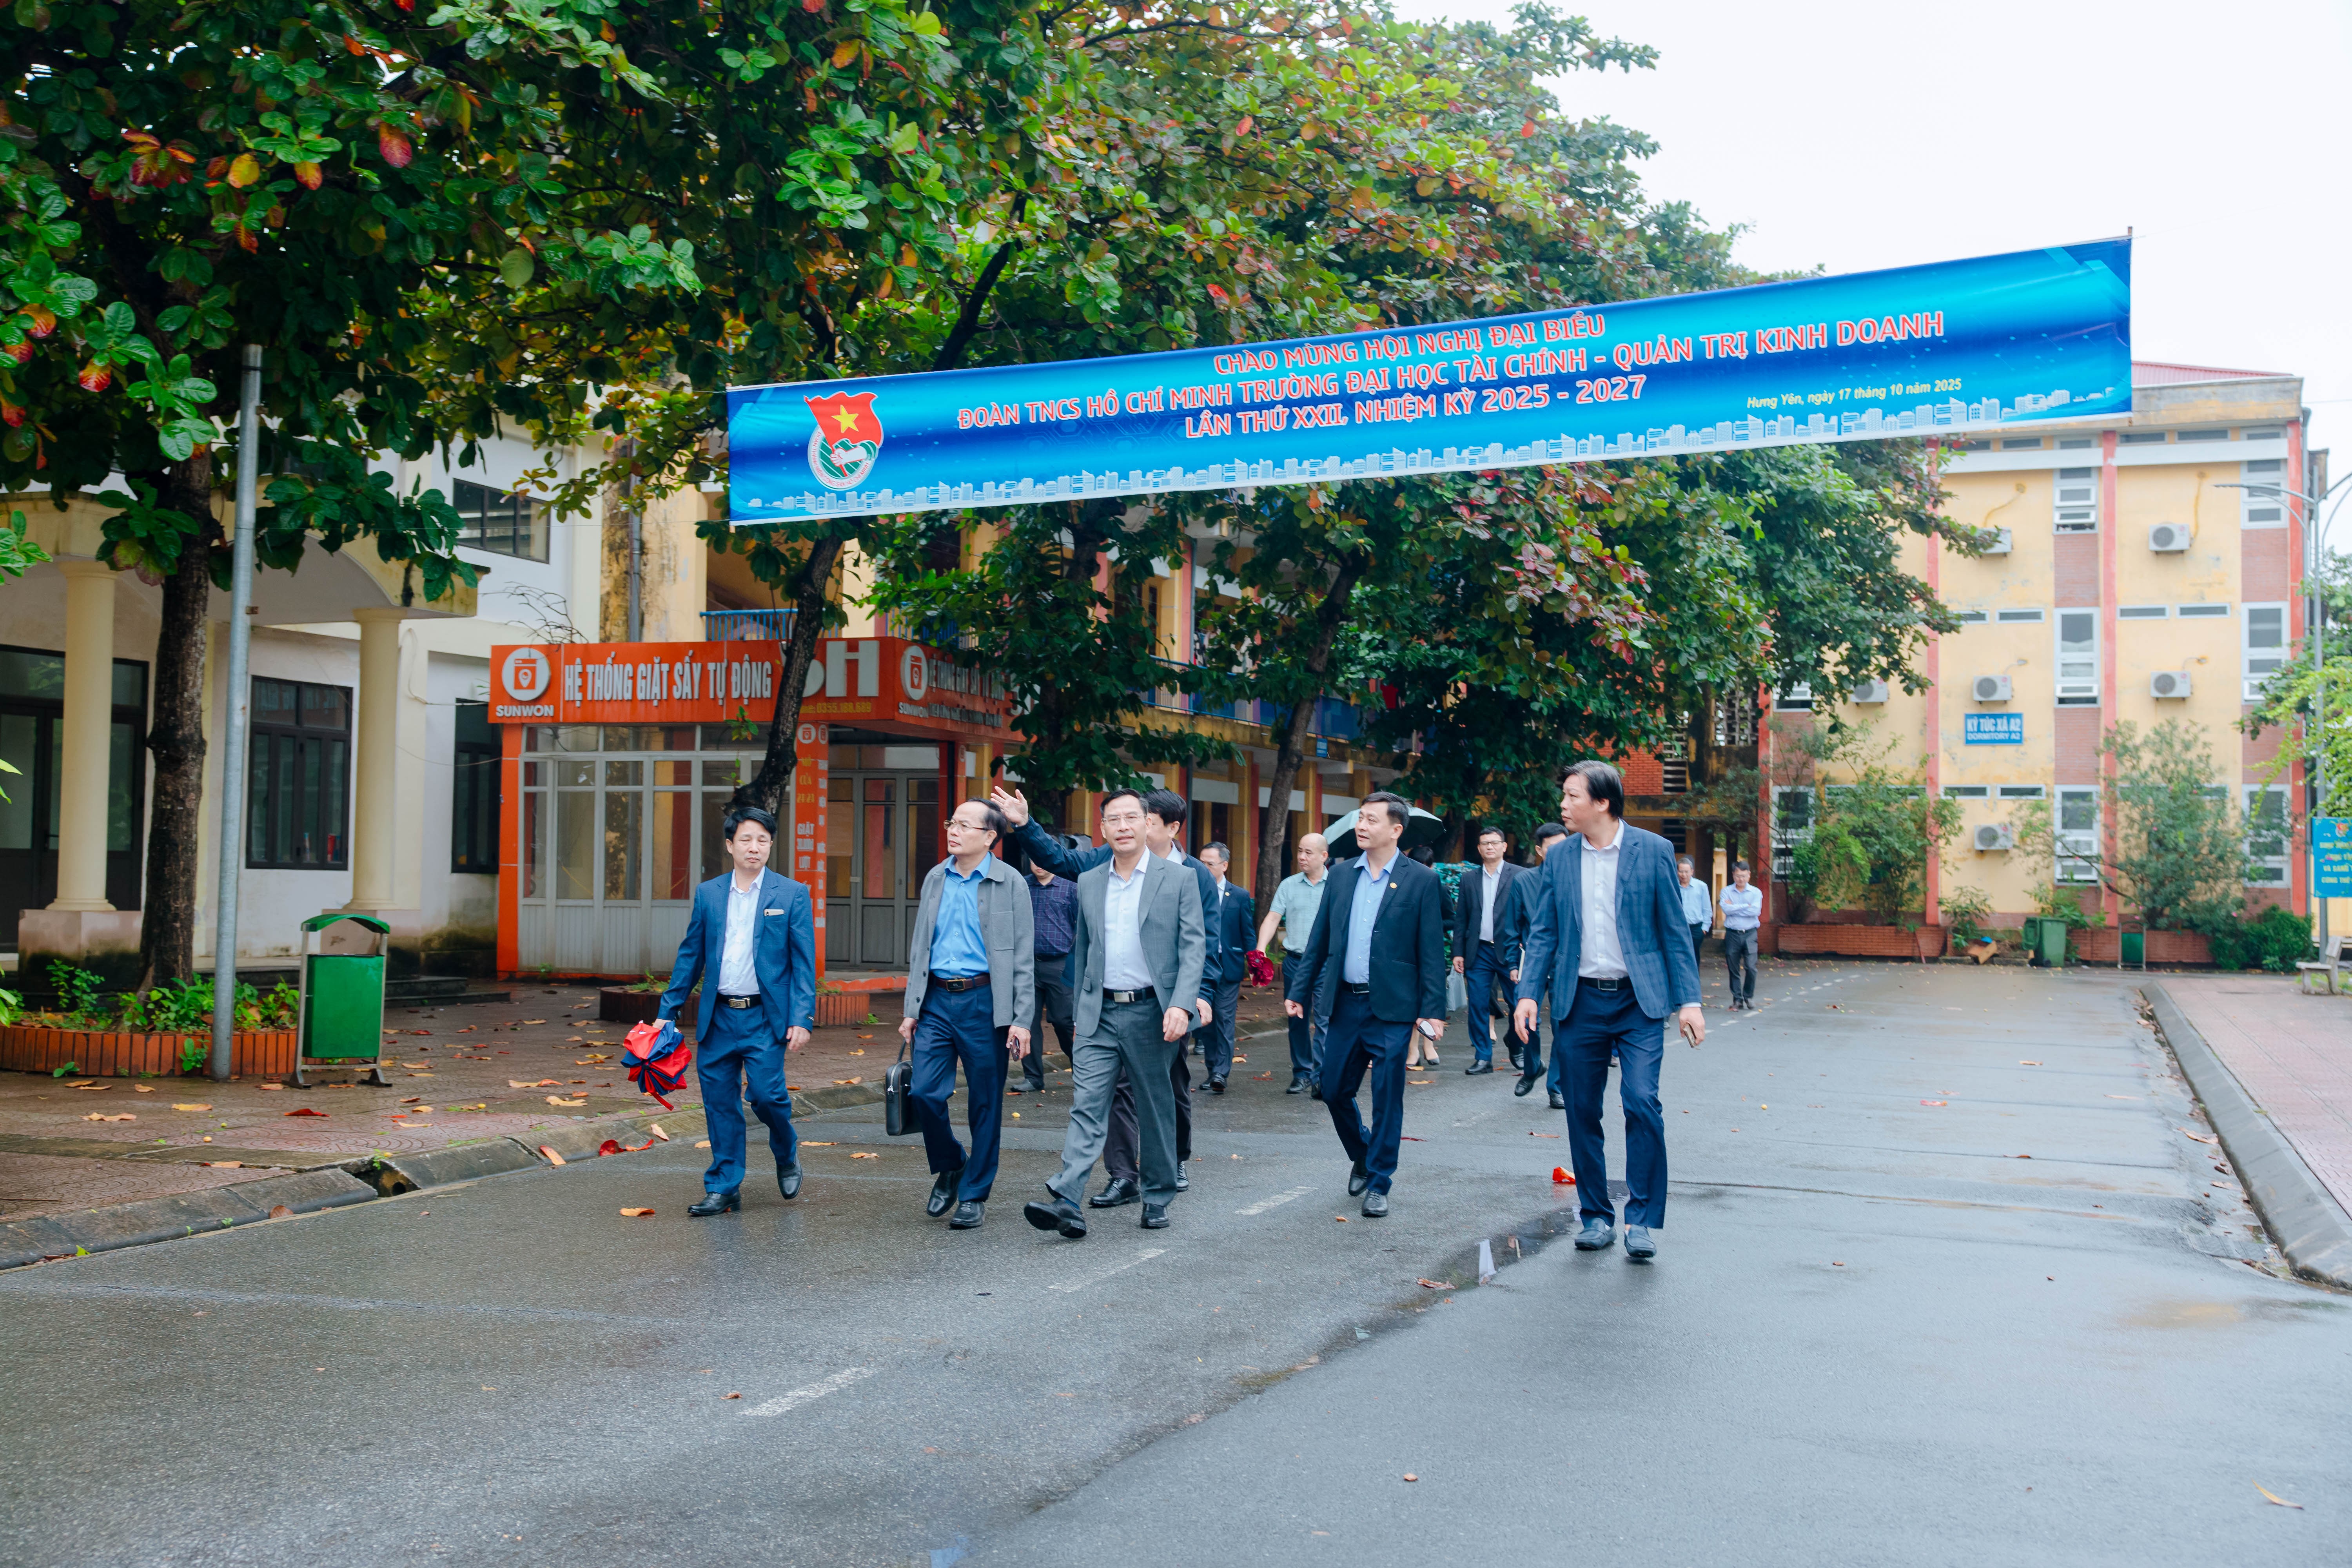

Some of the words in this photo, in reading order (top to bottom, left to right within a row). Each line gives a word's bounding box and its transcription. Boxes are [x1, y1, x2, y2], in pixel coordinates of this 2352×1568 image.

[957, 402, 1020, 430] ĐOÀN
[1025, 397, 1082, 423] TNCS
[1087, 389, 1120, 418] HỒ
[1125, 386, 1163, 413] CHÍ
[1169, 383, 1232, 410] MINH
[1239, 373, 1338, 404] TRƯỜNG
[1345, 367, 1390, 394] ĐẠI
[1396, 361, 1448, 389] HỌC
[1453, 354, 1498, 383] TÀI
[1504, 348, 1587, 378] CHÍNH
[1613, 334, 1693, 372] QUẢN
[1700, 331, 1748, 359] TRỊ
[1755, 323, 1828, 354] KINH
[1836, 311, 1944, 346] DOANH
[1214, 348, 1278, 375] CHÀO
[1283, 341, 1358, 368] MỪNG
[1363, 334, 1411, 361] HỘI
[1416, 328, 1483, 354] NGHỊ
[1488, 321, 1537, 349] ĐẠI
[1543, 310, 1605, 342] BIỂU
[1185, 409, 1231, 438] LẦN
[1236, 405, 1289, 433] THỨ
[1292, 403, 1348, 429] XXII,
[1355, 392, 1437, 423] NHIỆM
[1444, 387, 1476, 416] KỲ
[1482, 384, 1550, 413] 2025
[1575, 374, 1646, 404] 2027
[1746, 396, 1778, 410] Hưng
[1780, 392, 1804, 406] Yên,
[1808, 390, 1835, 406] ngày
[1838, 388, 1852, 400] 17
[1854, 385, 1887, 400] tháng
[1890, 383, 1904, 396] 10
[1905, 381, 1931, 394] năm
[1934, 378, 1962, 392] 2025
[564, 657, 583, 707] HỆ
[586, 651, 633, 701] THỐNG
[637, 656, 669, 706] GIẶT
[673, 650, 702, 700] SẤY
[708, 659, 728, 705] TỰ
[731, 654, 771, 705] ĐỘNG
[496, 705, 554, 717] SUNWON
[2009, 718, 2021, 732] A2
